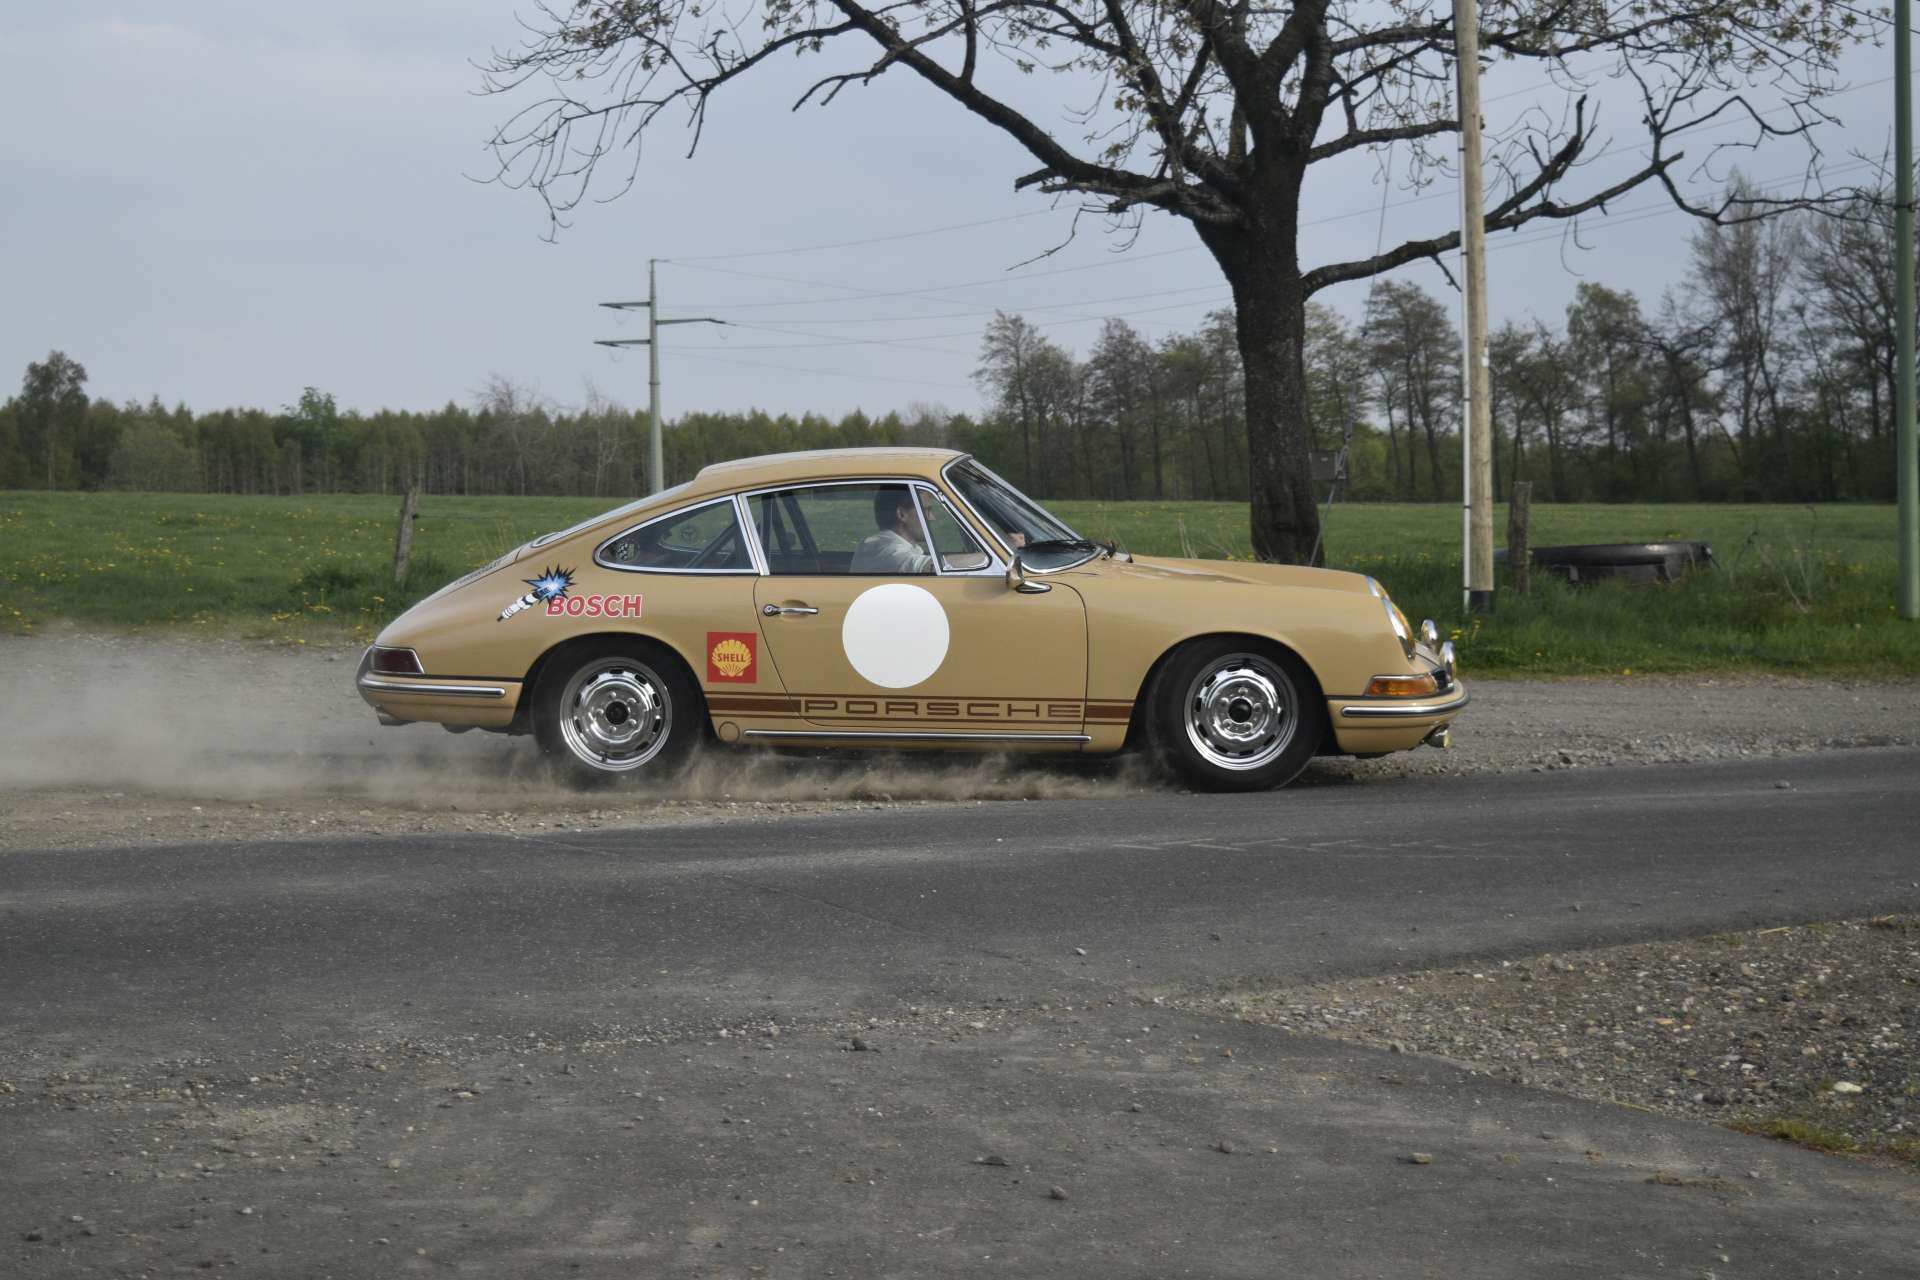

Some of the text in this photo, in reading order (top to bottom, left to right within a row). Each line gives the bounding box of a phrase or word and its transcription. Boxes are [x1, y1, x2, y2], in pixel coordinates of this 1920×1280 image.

[546, 595, 642, 617] BOSCH
[717, 652, 746, 663] SHELL
[804, 700, 1081, 718] PORSCHE
